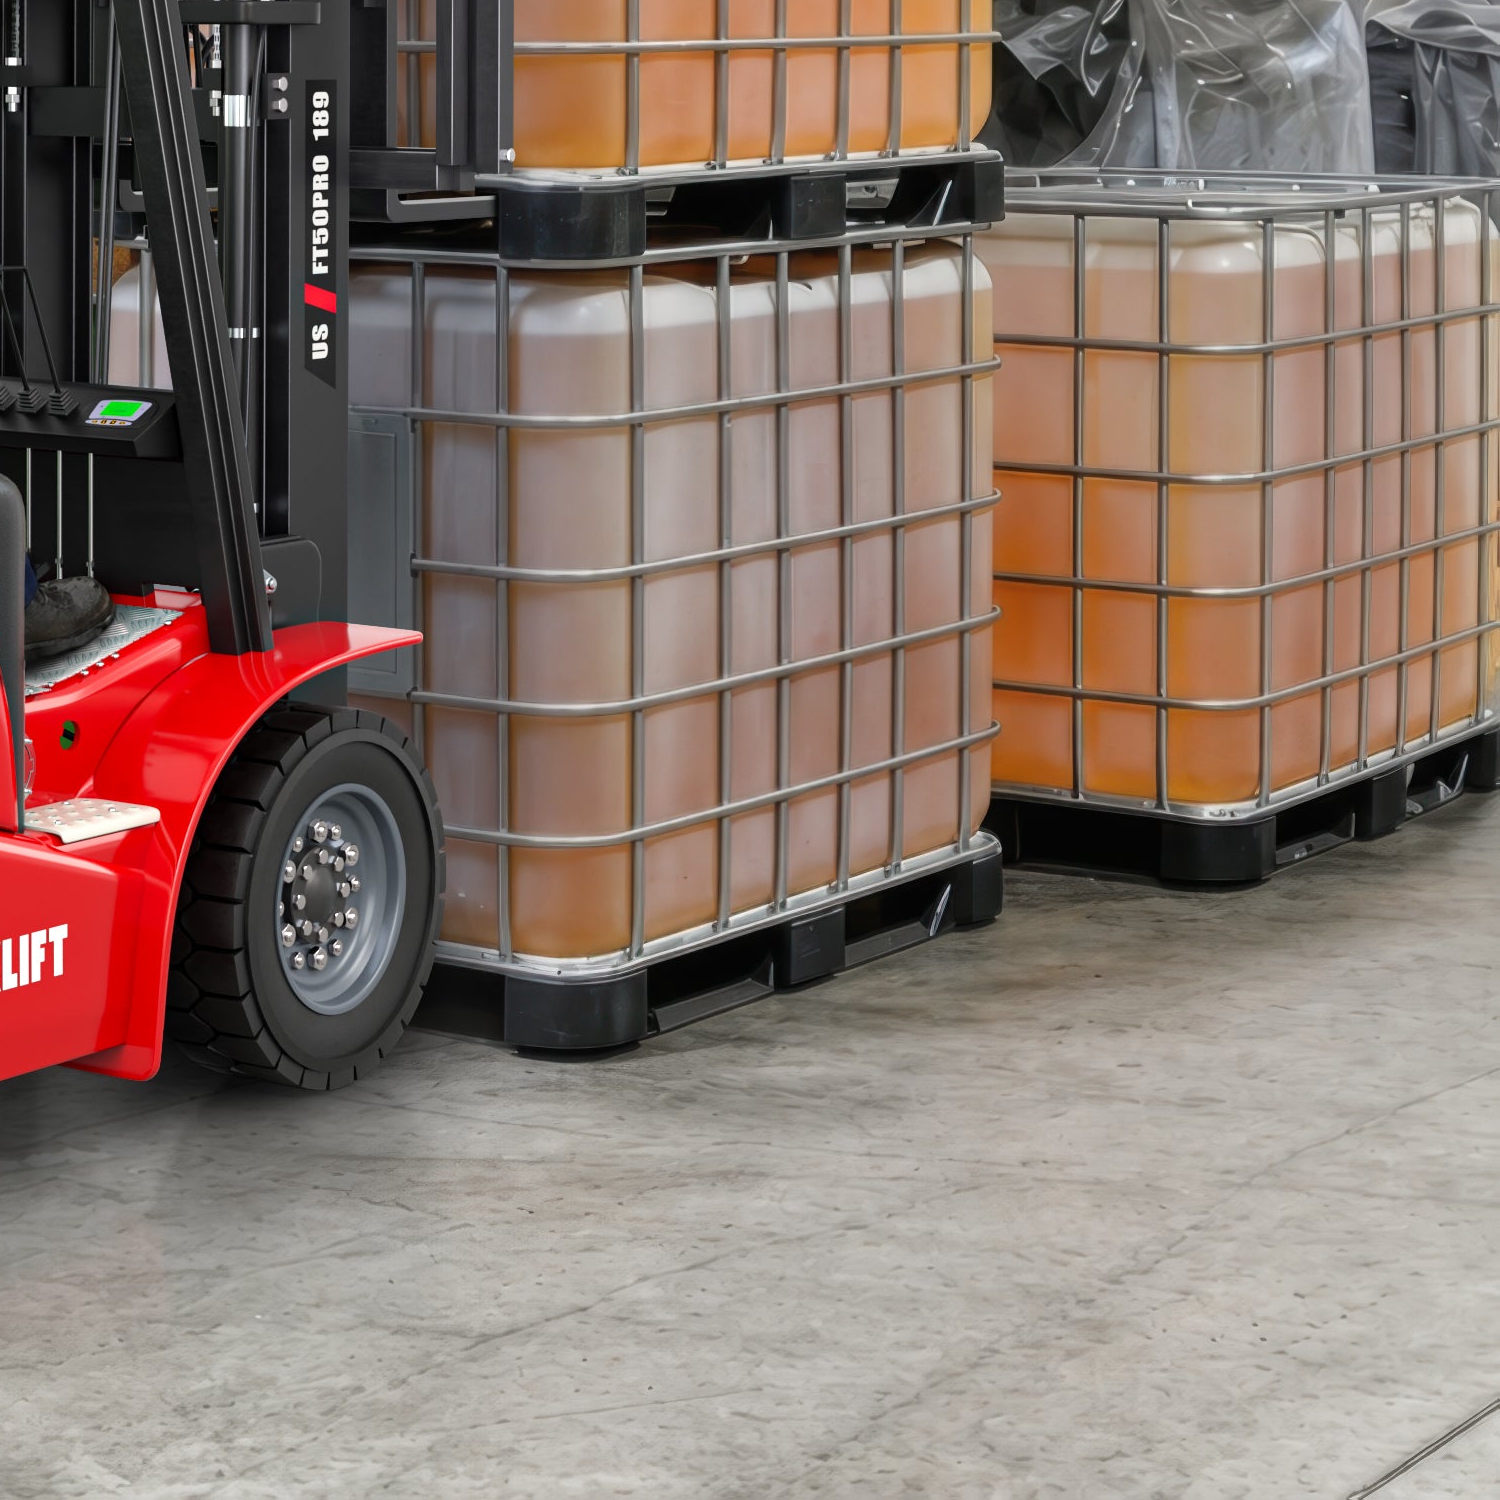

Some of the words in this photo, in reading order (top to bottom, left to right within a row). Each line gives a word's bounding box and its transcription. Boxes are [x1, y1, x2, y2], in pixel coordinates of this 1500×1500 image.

[311, 91, 330, 141] 189
[311, 154, 330, 275] FT50PRO
[311, 323, 329, 360] US
